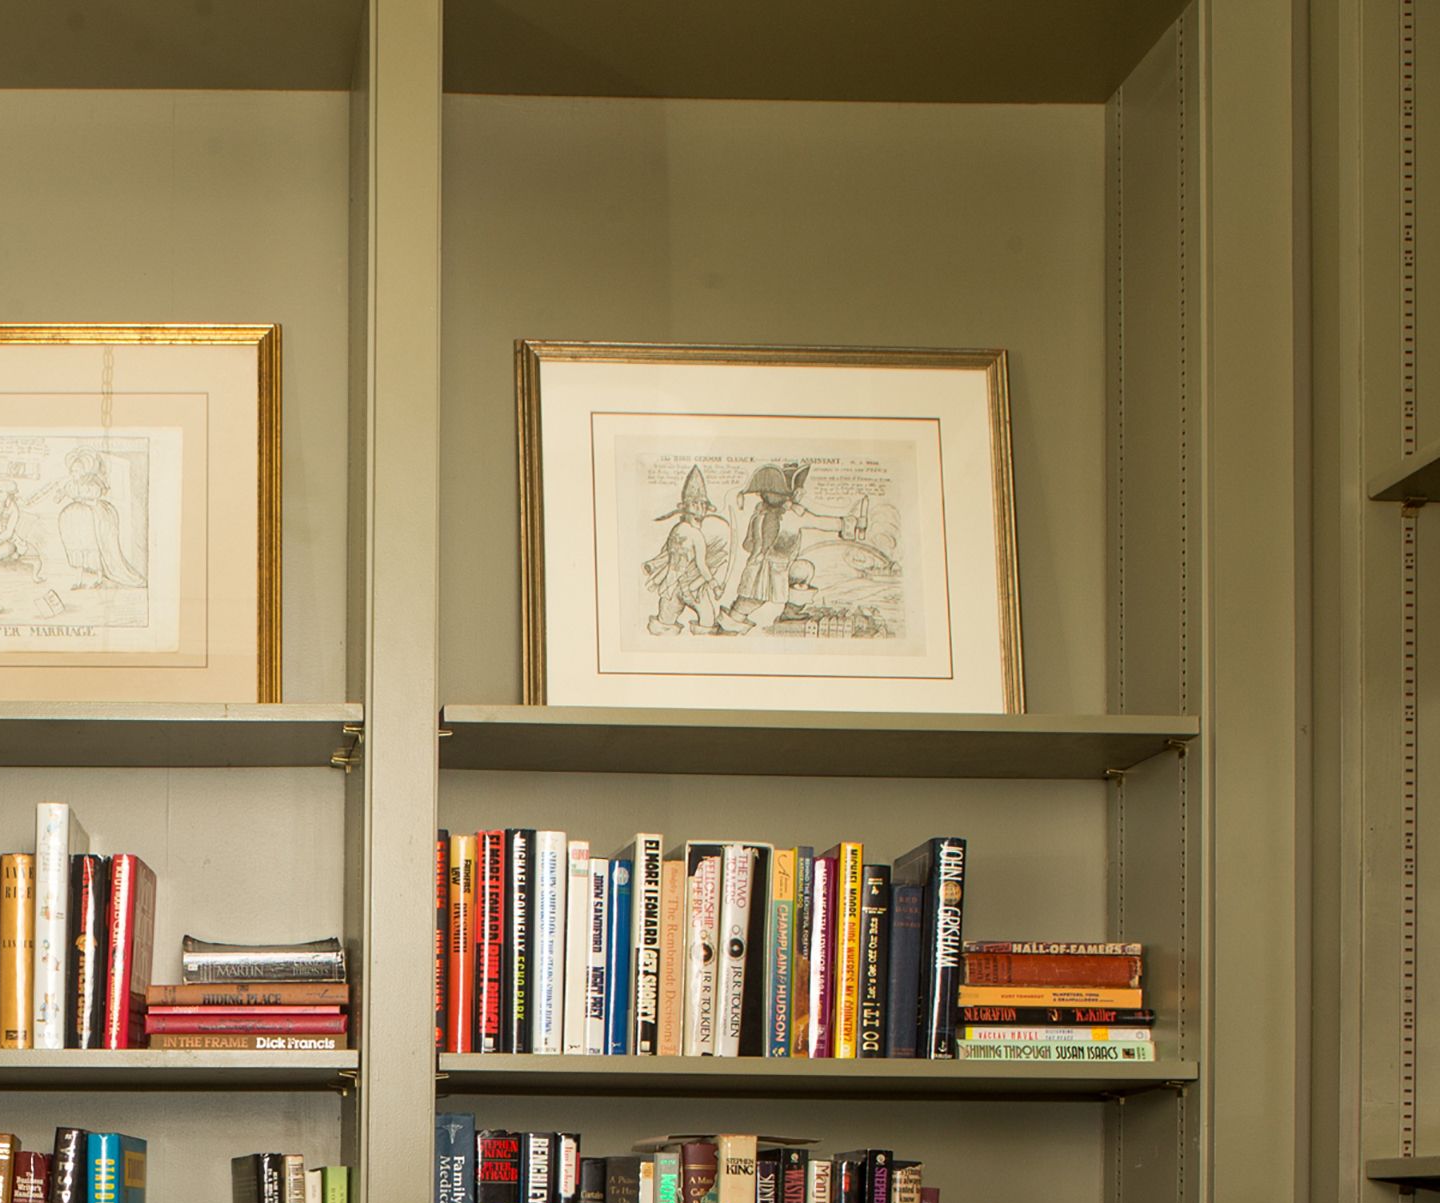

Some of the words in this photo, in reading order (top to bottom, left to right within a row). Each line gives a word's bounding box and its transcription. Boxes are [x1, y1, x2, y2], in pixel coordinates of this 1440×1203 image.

[30, 626, 96, 638] MARRIAGE
[738, 855, 748, 876] THE
[938, 845, 964, 881] JOHN
[736, 878, 747, 909] TWO
[776, 904, 789, 974] CHAMPLAIN
[935, 906, 960, 968] GRISHAM
[216, 965, 264, 977] MARTIN
[700, 997, 711, 1043] TOLKIEN
[774, 984, 787, 1042] HUDSON
[862, 1002, 880, 1028] IT!
[964, 1008, 979, 1021] SUE
[979, 1008, 1017, 1021] GRAFTON
[163, 1037, 177, 1048] IN
[179, 1037, 201, 1048] THE
[204, 1037, 248, 1048] FRAME
[256, 1036, 286, 1049] Dick
[287, 1036, 335, 1049] Francis
[862, 1029, 880, 1051] DO
[965, 1045, 1002, 1059] SHINING
[1003, 1045, 1051, 1059] THROUGH
[1055, 1045, 1085, 1059] SUSAN
[1087, 1045, 1119, 1060] ISAACS
[479, 1139, 519, 1151] STEPHEN
[485, 1150, 511, 1158] KING
[726, 1157, 754, 1165] STEPHEN
[482, 1162, 511, 1172] PETER
[725, 1164, 754, 1175] KING
[478, 1170, 518, 1181] STRAUB
